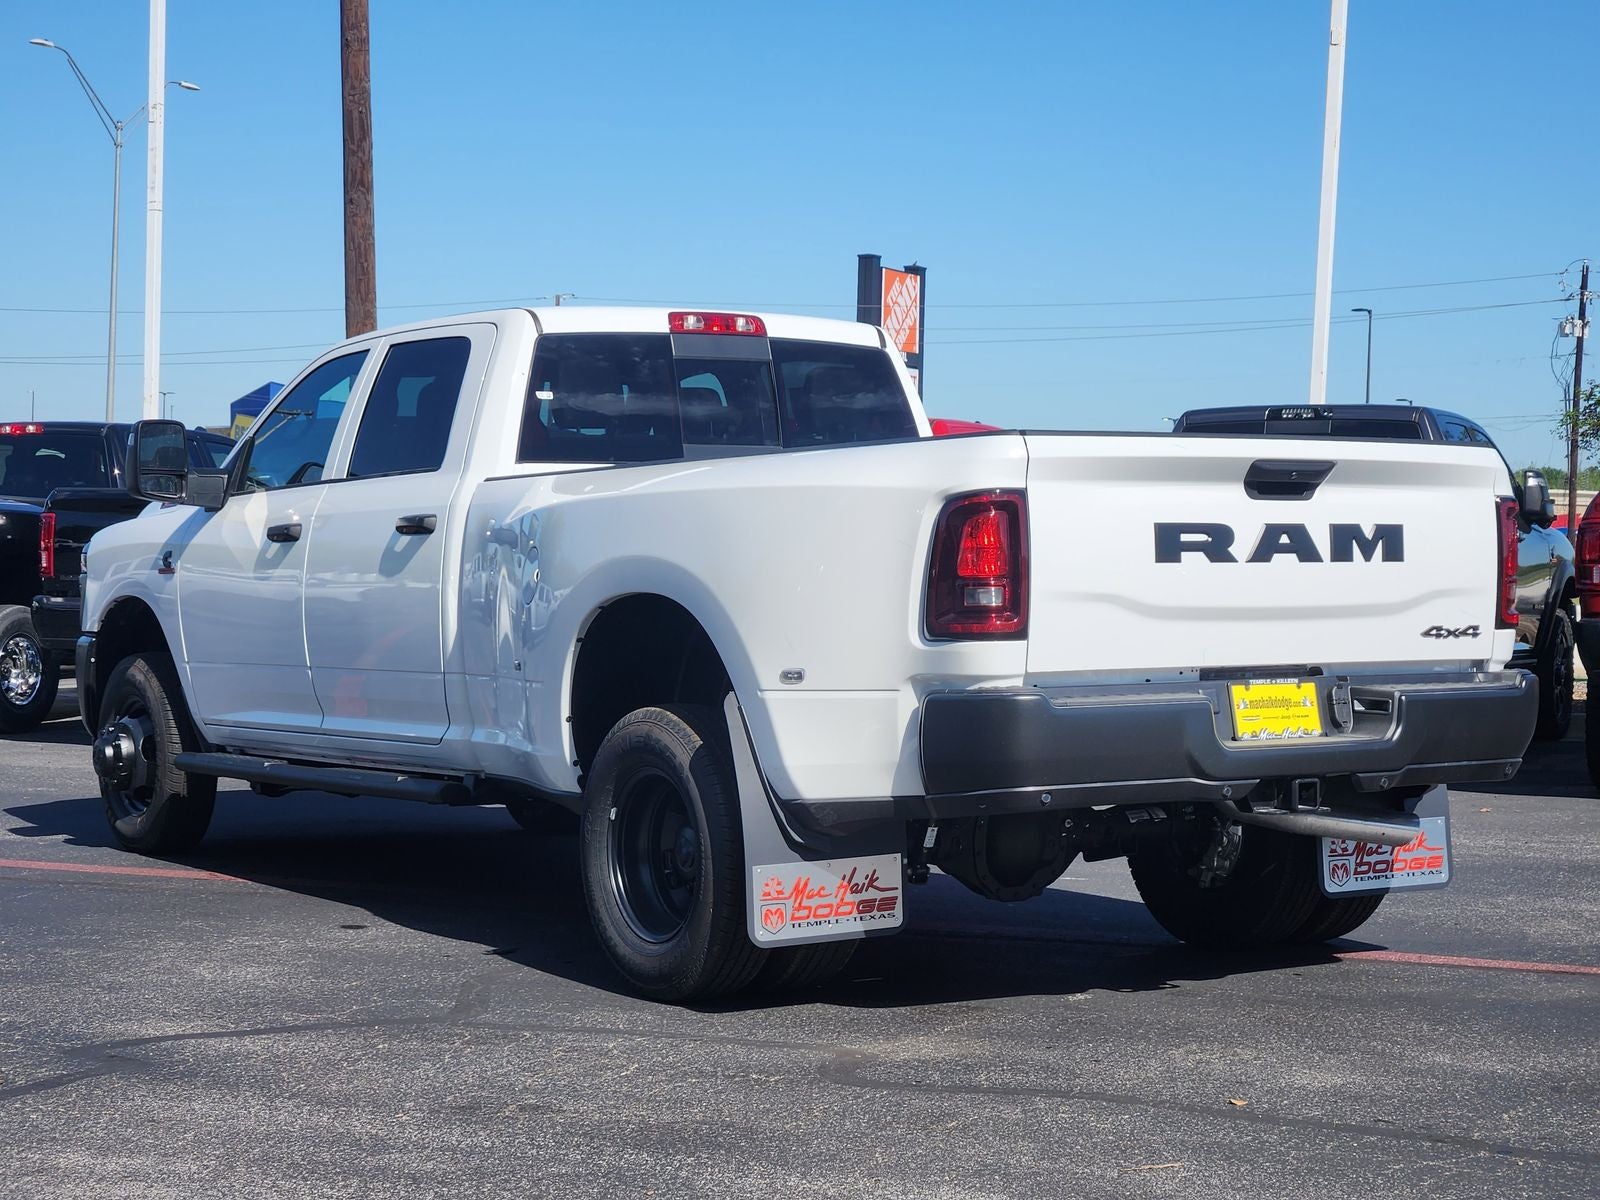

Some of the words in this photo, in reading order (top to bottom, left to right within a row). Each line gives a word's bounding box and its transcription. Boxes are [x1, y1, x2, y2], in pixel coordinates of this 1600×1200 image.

[882, 273, 918, 343] HOME
[1153, 521, 1405, 564] RAM
[1420, 624, 1482, 640] 4x4
[1353, 840, 1389, 865] Mac
[1352, 855, 1444, 876] DODGE
[1354, 871, 1398, 882] TEMPLE
[1406, 869, 1443, 878] TEXAS
[786, 876, 833, 912] Mac
[834, 866, 899, 905] Haik
[789, 896, 899, 922] DODGE
[790, 918, 844, 929] TEMPLE
[853, 911, 897, 922] TEXAS
